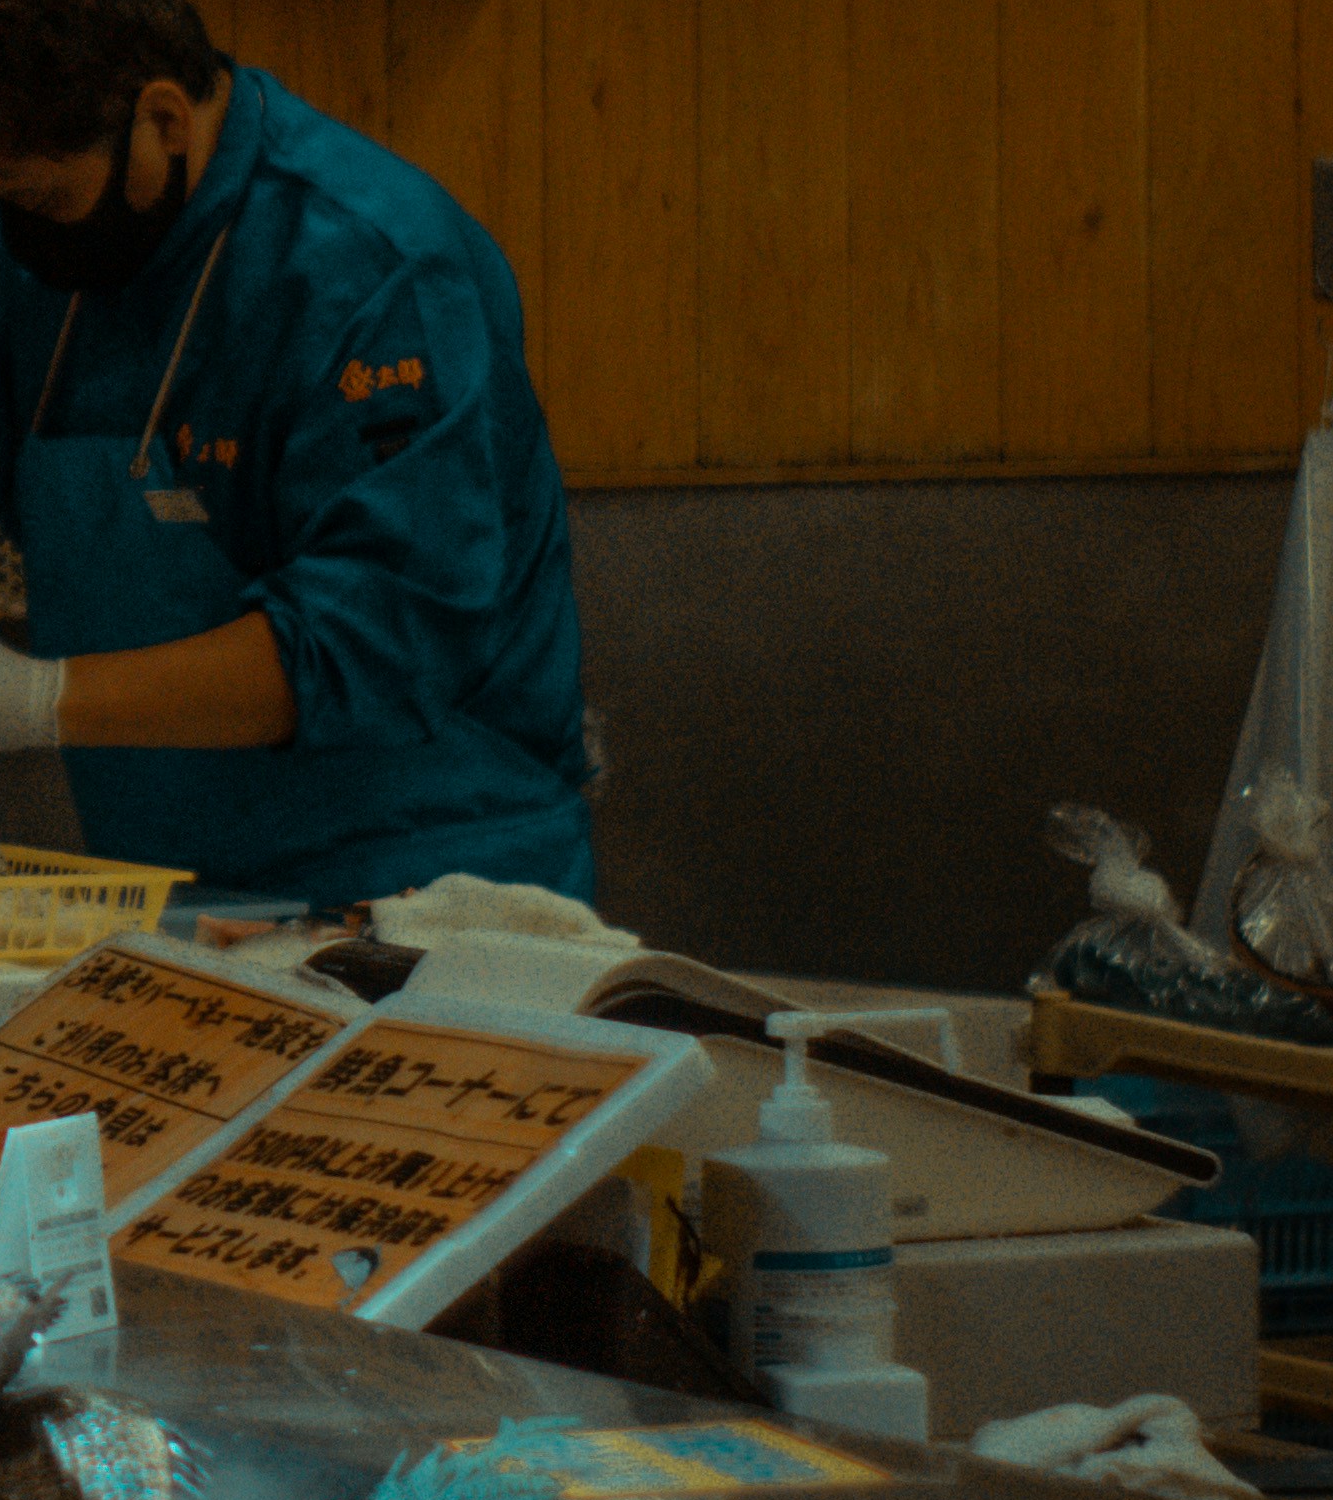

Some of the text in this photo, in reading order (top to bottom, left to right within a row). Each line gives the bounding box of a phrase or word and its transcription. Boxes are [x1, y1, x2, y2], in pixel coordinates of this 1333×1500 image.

[310, 1046, 603, 1126] 鮮魚コーナーにて
